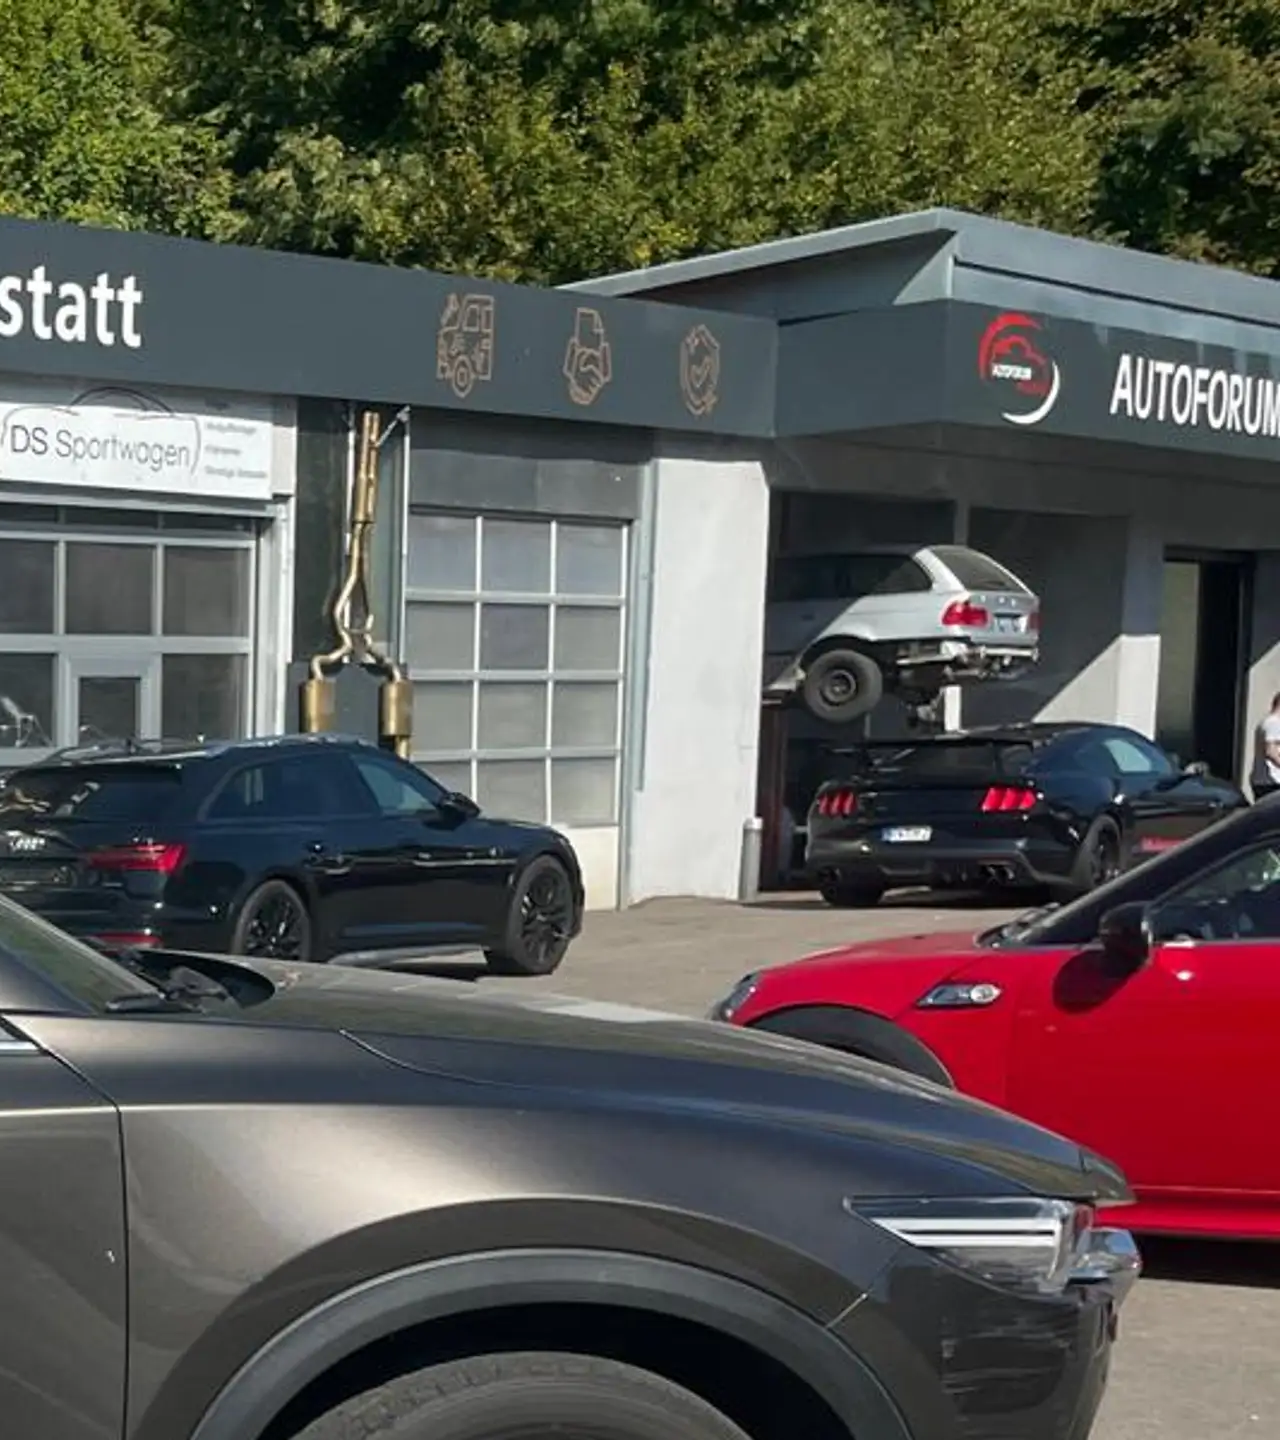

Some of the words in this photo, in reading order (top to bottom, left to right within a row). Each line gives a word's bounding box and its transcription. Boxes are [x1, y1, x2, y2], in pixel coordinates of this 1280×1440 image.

[1109, 353, 1280, 438] AUTOFORUM
[9, 424, 48, 455] DS
[55, 429, 190, 472] Sportwagen
